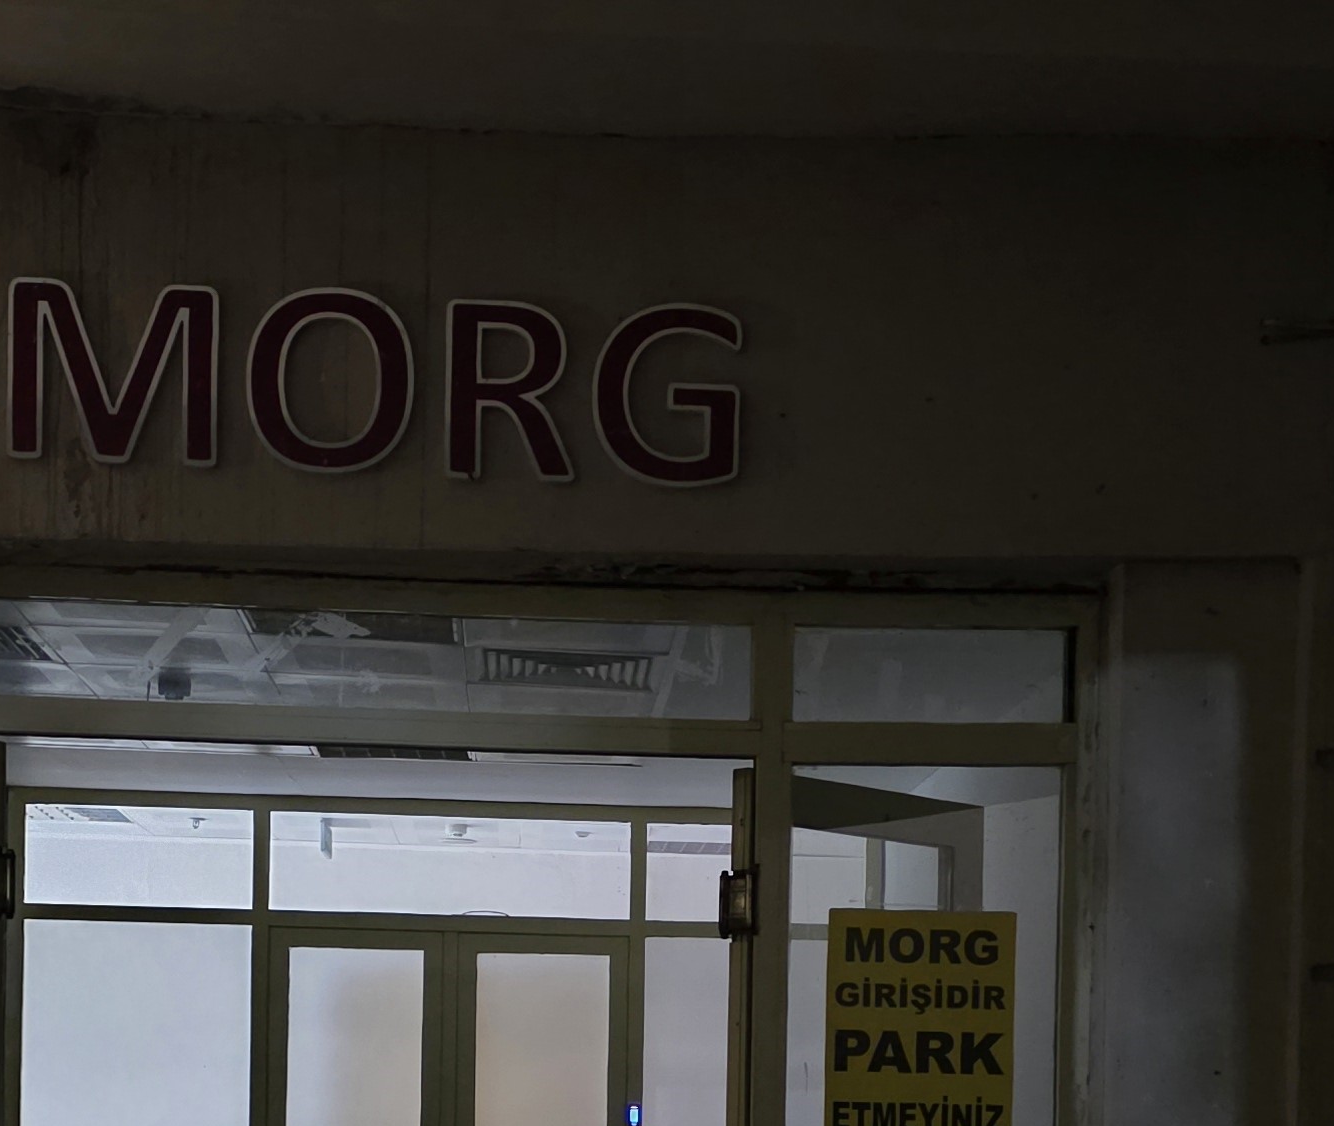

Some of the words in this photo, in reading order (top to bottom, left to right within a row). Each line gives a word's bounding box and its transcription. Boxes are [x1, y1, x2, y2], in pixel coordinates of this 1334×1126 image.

[7, 276, 743, 488] MORG
[844, 926, 999, 966] MORG
[834, 976, 1006, 1015] GİRİŞİDİR
[833, 1029, 1005, 1076] PARK
